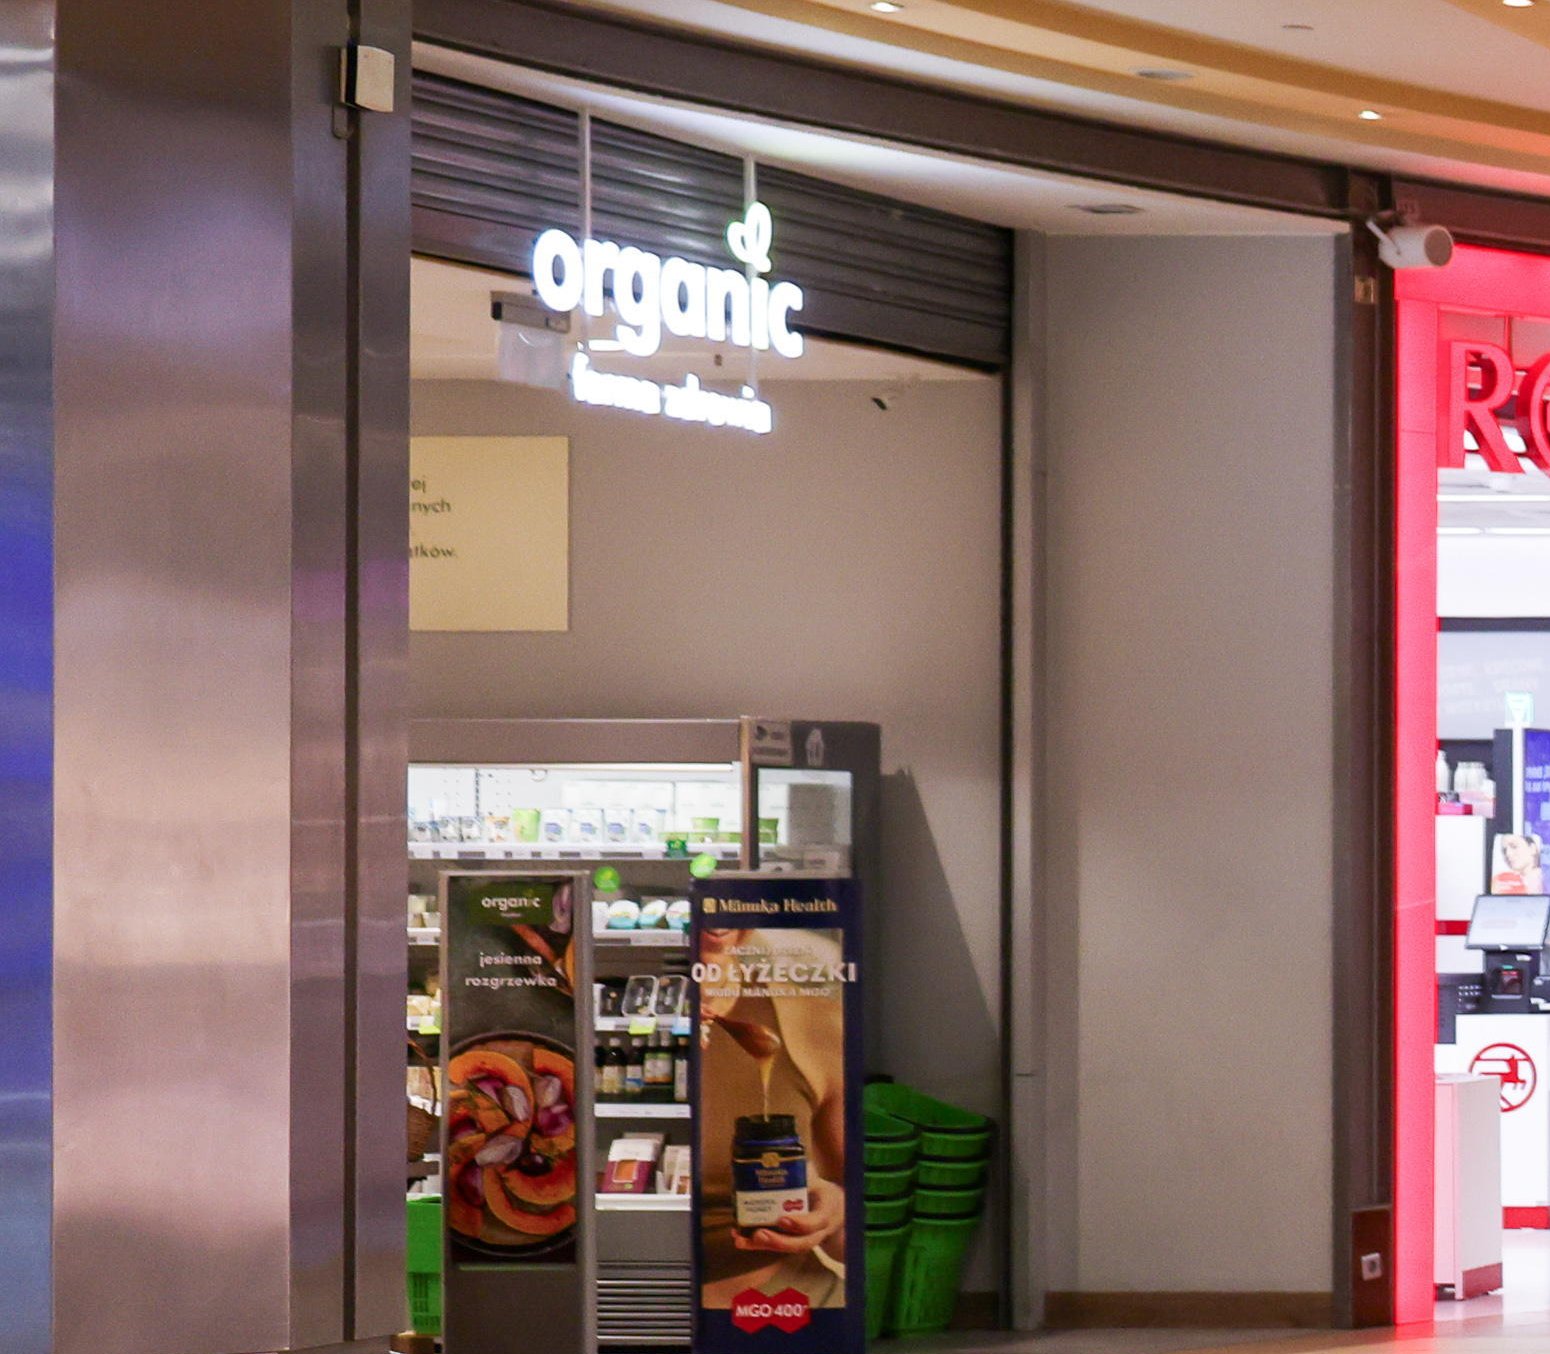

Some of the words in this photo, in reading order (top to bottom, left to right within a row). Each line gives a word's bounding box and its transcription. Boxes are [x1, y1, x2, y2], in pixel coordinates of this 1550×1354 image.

[532, 228, 804, 357] organic
[784, 898, 838, 913] Health
[479, 952, 542, 968] jesienna
[691, 963, 722, 983] OD
[729, 957, 858, 983] ŁYŻECZKI
[465, 974, 558, 990] rozgrzewka
[736, 1304, 773, 1318] MGO
